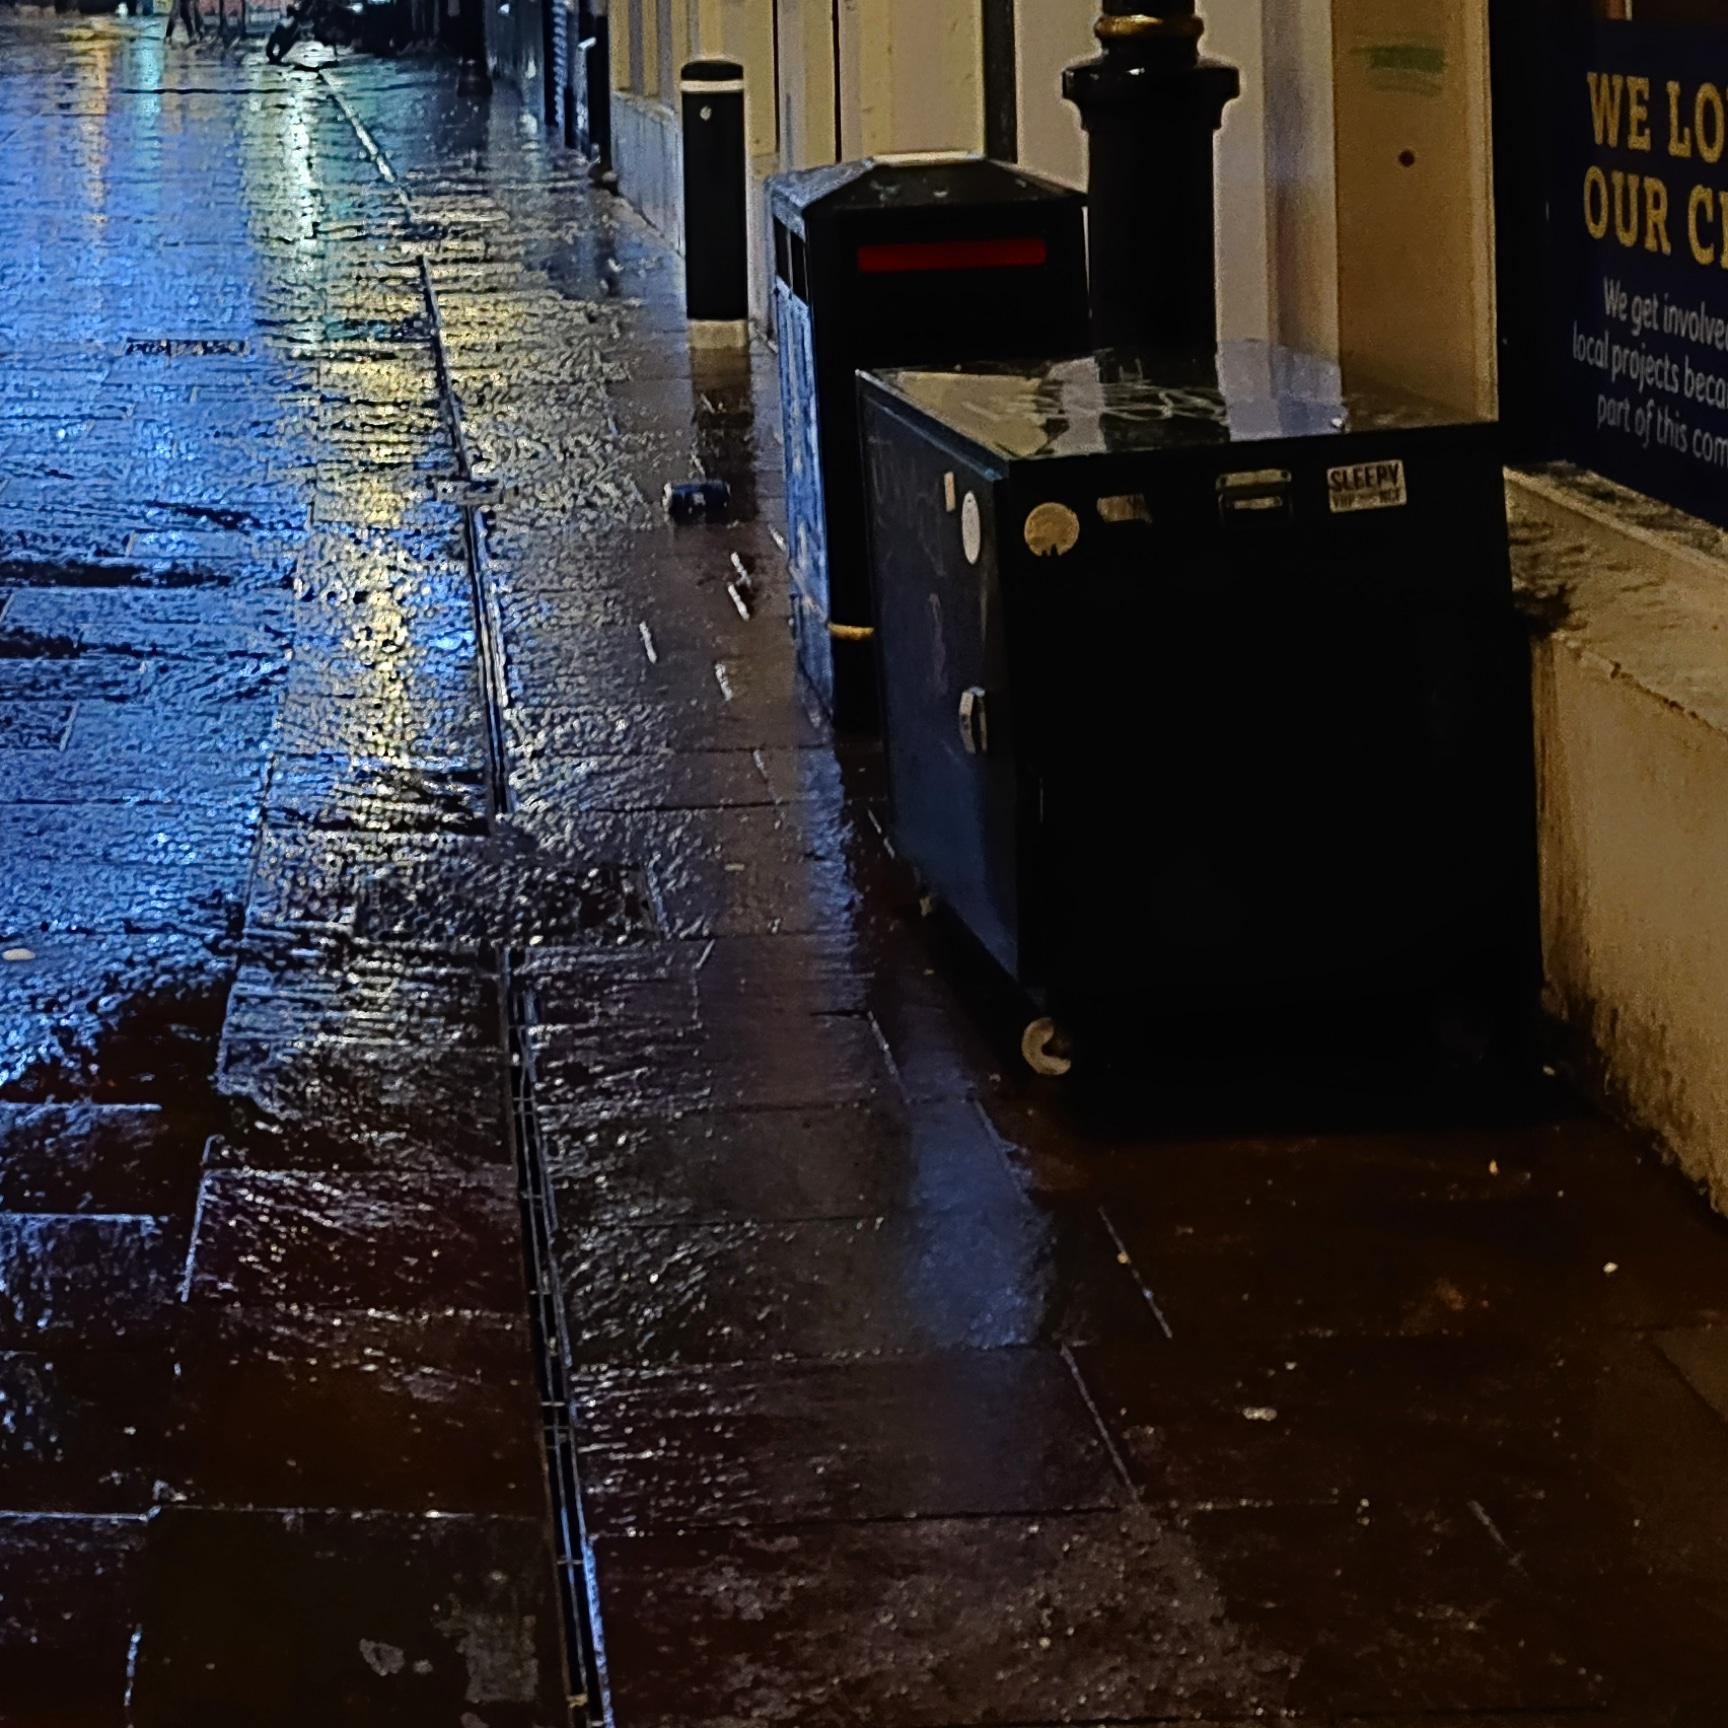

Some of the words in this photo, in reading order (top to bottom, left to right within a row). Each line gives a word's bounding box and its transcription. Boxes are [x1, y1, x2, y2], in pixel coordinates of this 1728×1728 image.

[1586, 72, 1651, 152] WE
[1666, 80, 1728, 164] LO
[1584, 165, 1672, 256] OUR
[1604, 276, 1628, 321] We
[1631, 292, 1659, 337] get
[1573, 320, 1609, 369] local
[1611, 342, 1679, 394] projects
[1684, 354, 1728, 410] beca
[1597, 393, 1630, 433] part
[1635, 398, 1655, 449] of
[1657, 405, 1688, 453] this
